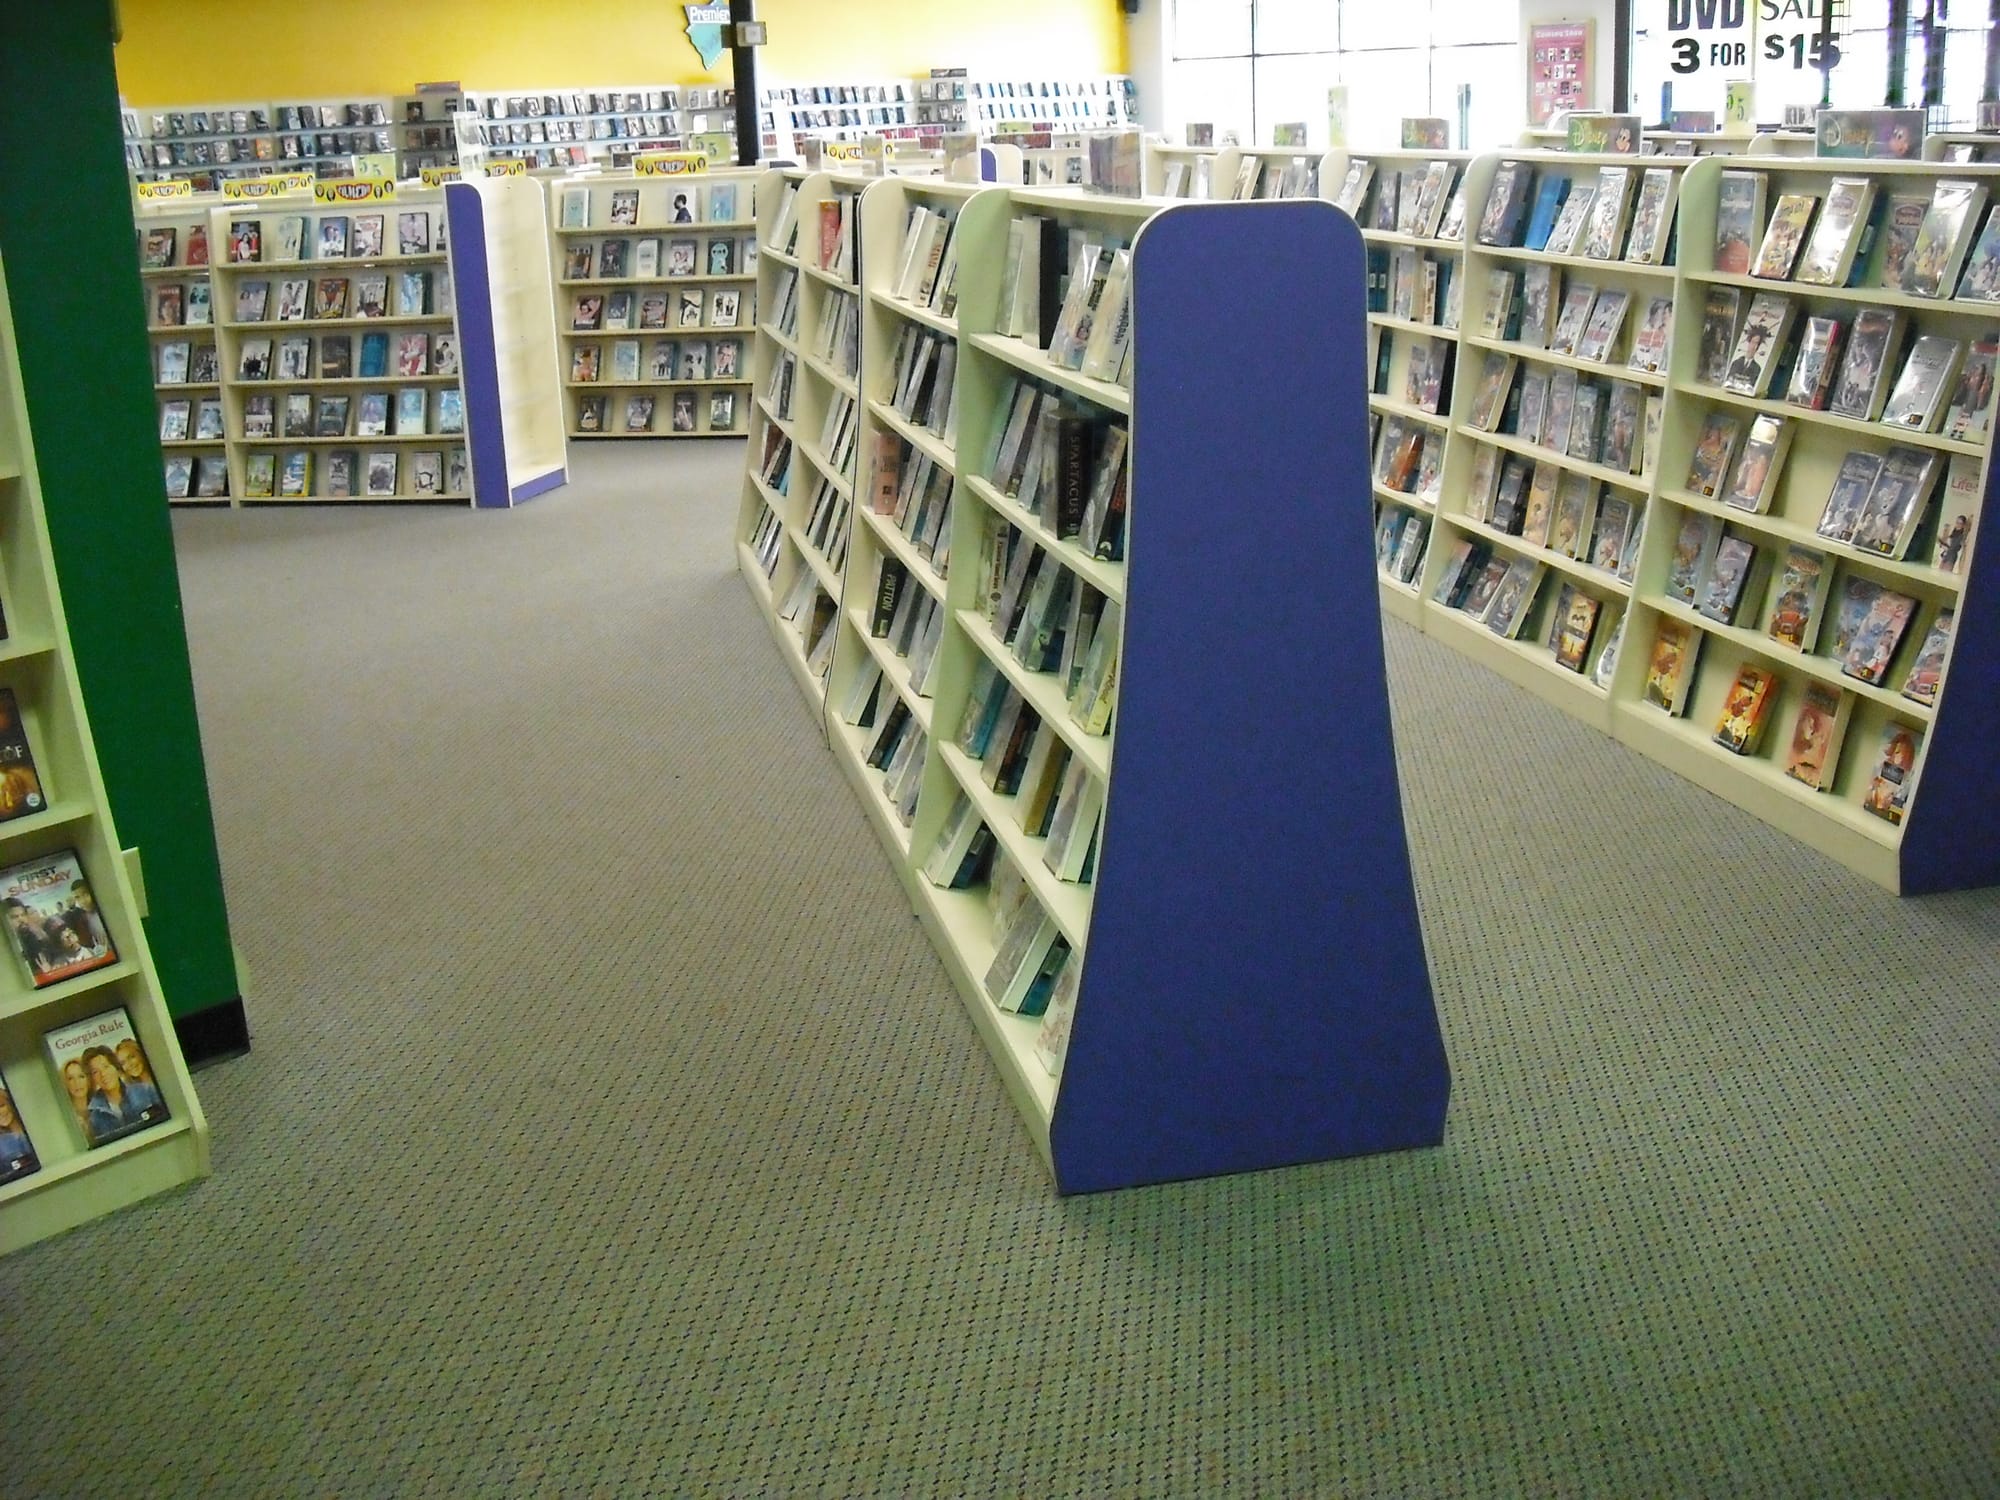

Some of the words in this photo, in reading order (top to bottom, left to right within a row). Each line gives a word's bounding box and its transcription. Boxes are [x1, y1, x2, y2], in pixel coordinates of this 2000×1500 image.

[1668, 0, 1745, 31] DVD
[1670, 37, 1700, 74] 3
[1710, 42, 1746, 67] FOR
[1067, 435, 1081, 516] SPARTACUS
[882, 573, 897, 611] PATTON
[8, 869, 72, 897] SUNDAY
[17, 866, 57, 884] FIRST
[55, 1030, 98, 1050] Georgia
[98, 1019, 124, 1036] Rule
